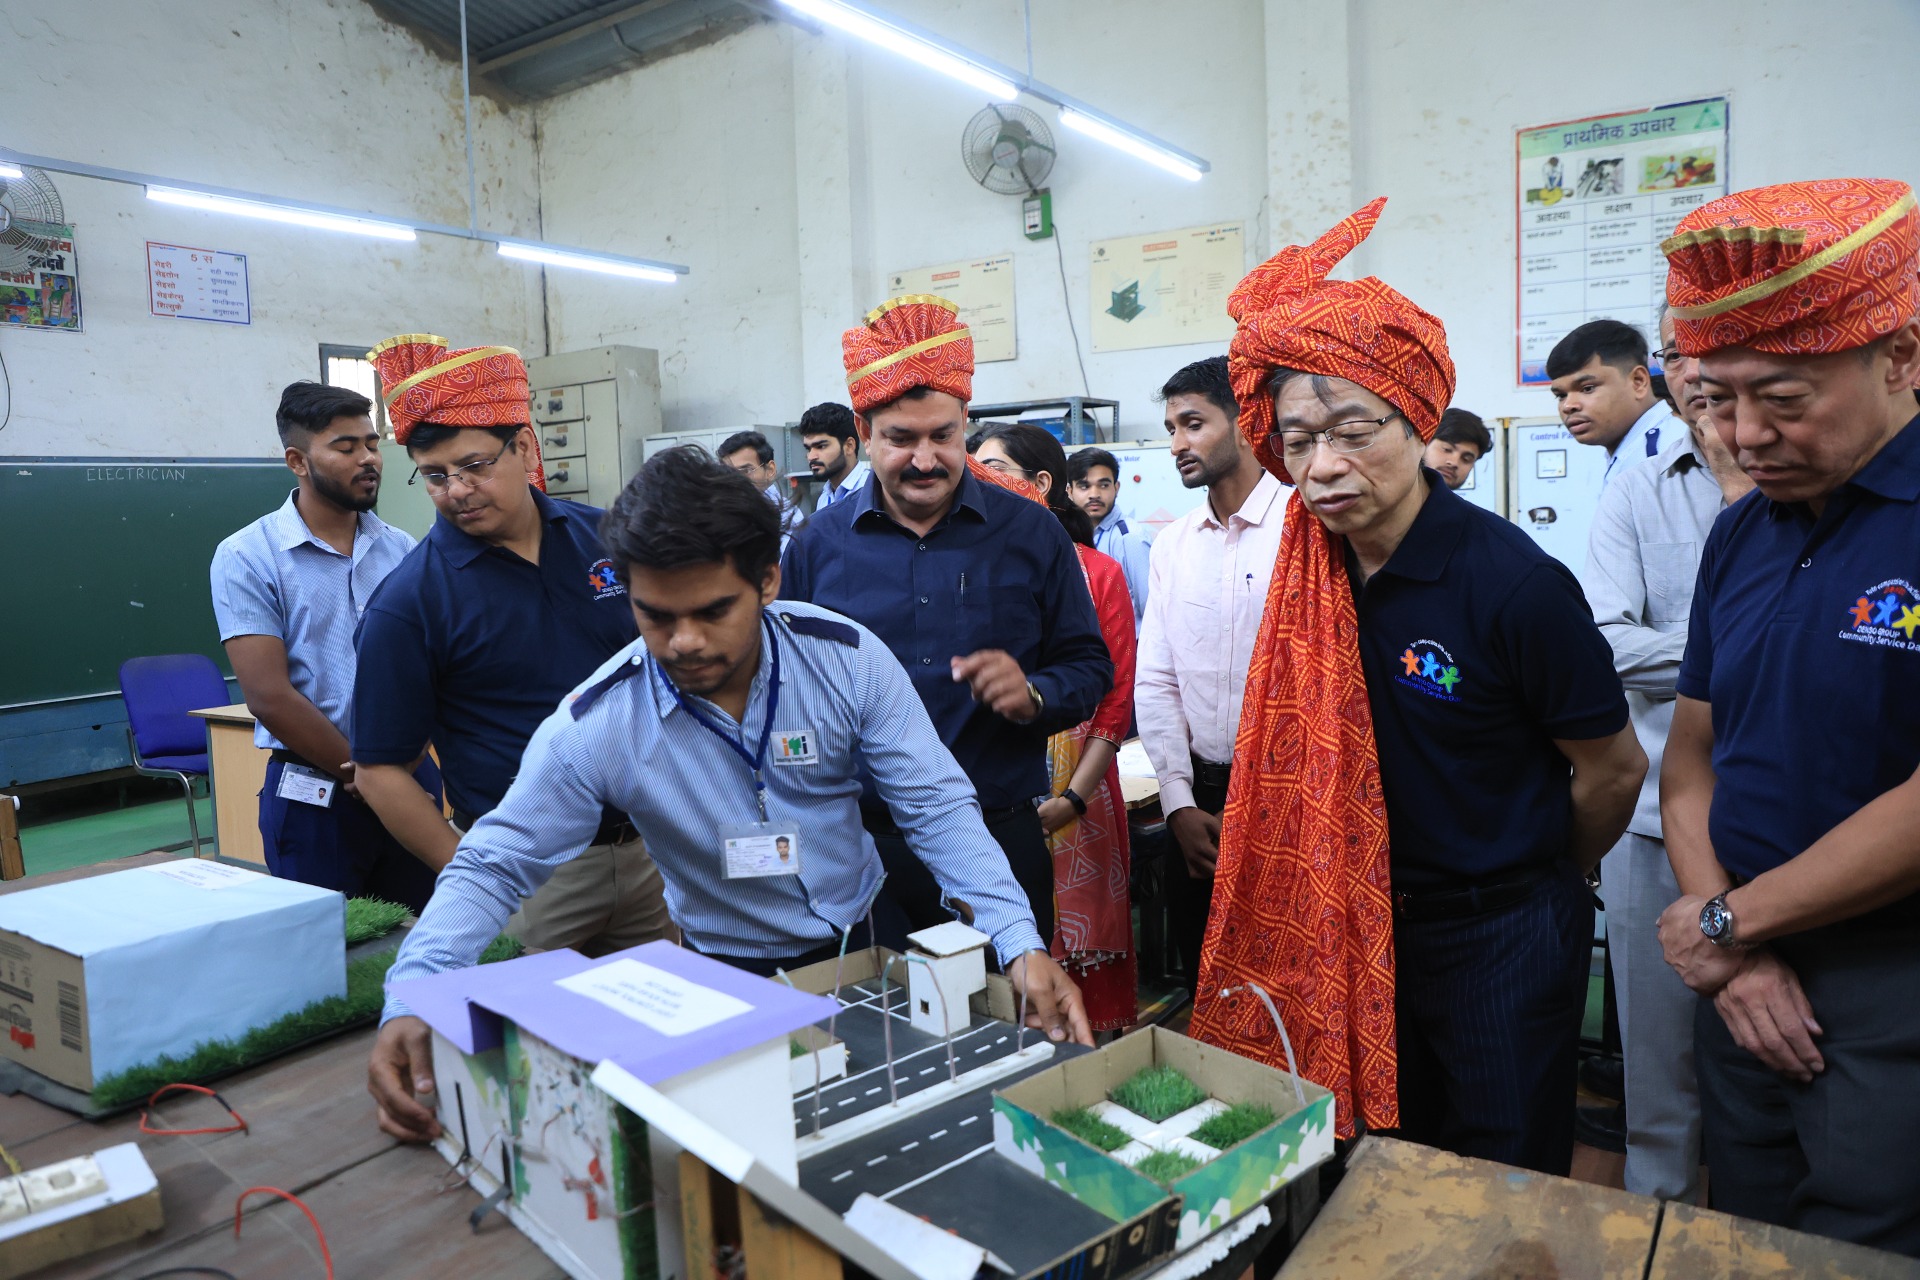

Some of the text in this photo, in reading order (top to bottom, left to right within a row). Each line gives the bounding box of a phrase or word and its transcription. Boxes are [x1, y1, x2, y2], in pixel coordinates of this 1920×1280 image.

[1563, 122, 1625, 148] प्राथमिक
[1629, 116, 1676, 137] उपचार
[190, 253, 214, 265] 5 स
[1530, 431, 1560, 442] Control
[87, 467, 186, 482] ELECTRICIAN
[1857, 626, 1901, 638] DENSO GROUP
[1839, 631, 1920, 652] Community Service Da
